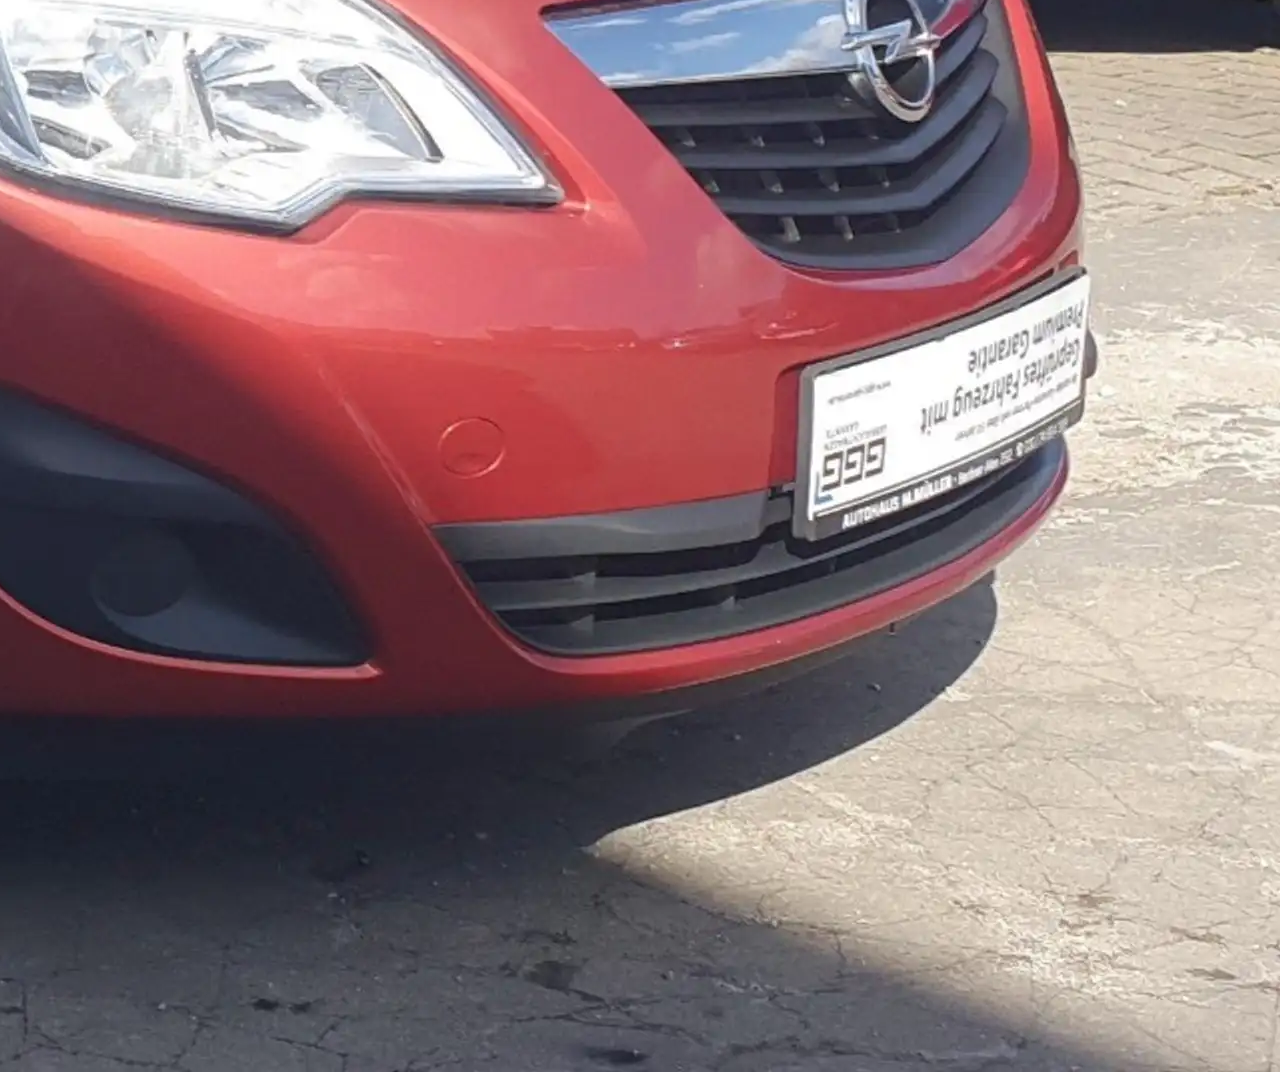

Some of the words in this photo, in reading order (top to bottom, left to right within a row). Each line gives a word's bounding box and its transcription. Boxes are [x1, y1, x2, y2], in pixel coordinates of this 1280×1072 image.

[1032, 299, 1084, 345] Premium
[968, 329, 1029, 379] Garantie
[1022, 336, 1081, 387] Geprüftes
[920, 399, 949, 436] mit
[952, 369, 1021, 418] Fahrzeug
[821, 436, 887, 492] GGG
[842, 495, 901, 530] AUTOHAUS
